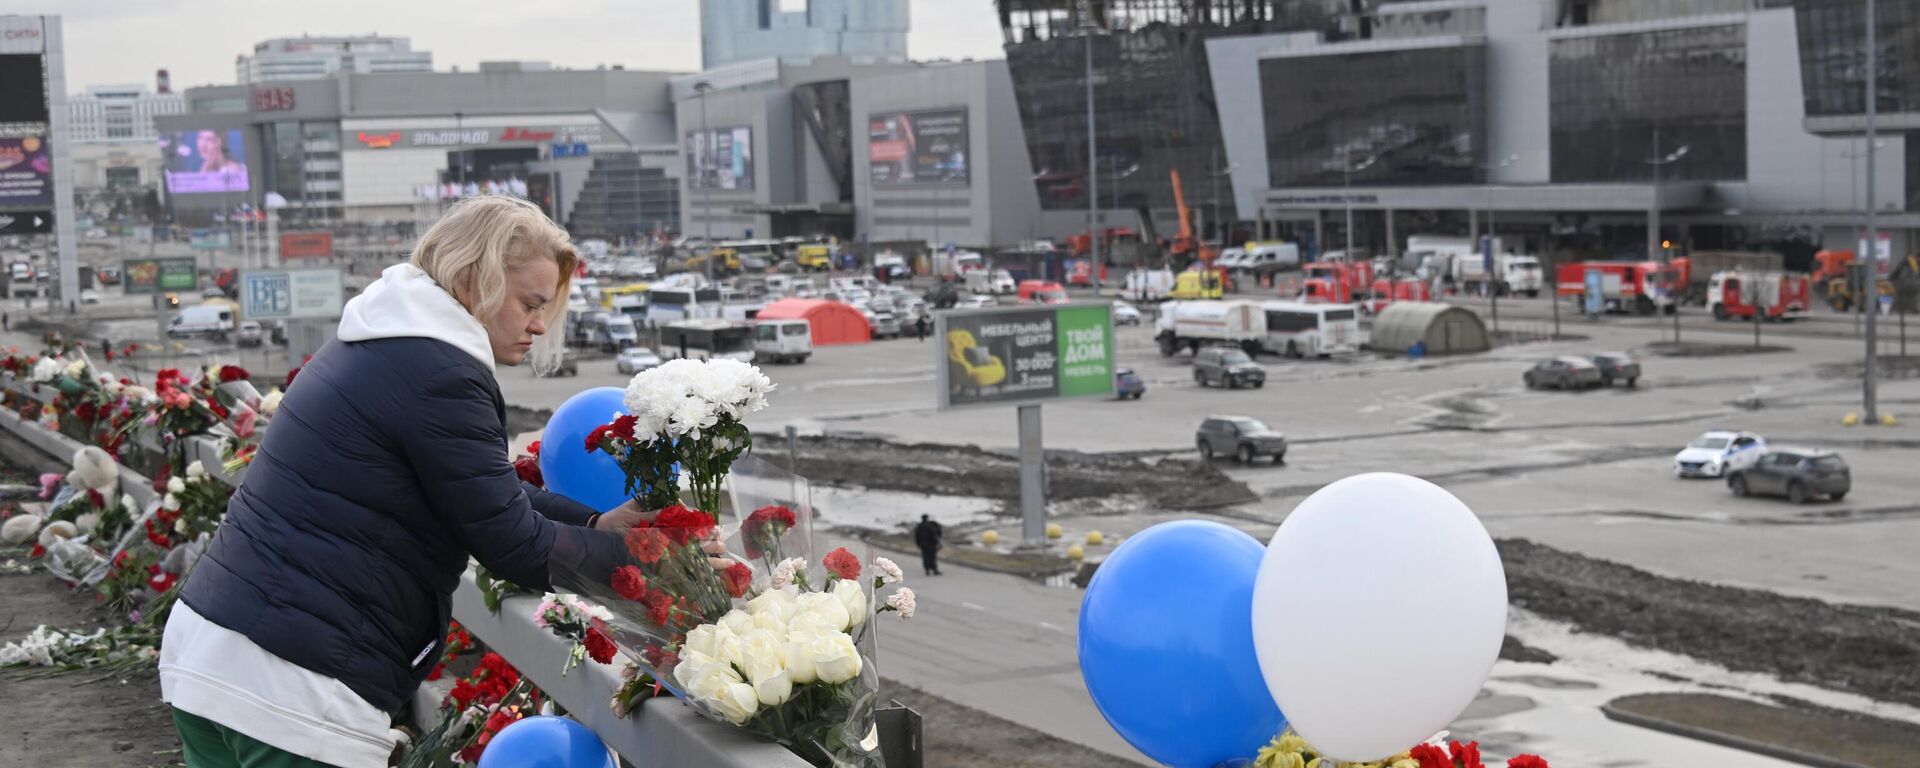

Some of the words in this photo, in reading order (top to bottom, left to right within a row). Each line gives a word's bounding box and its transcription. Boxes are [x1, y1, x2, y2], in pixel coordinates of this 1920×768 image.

[413, 130, 489, 146] ЭЛЬДОРАДО
[981, 320, 1052, 336] МЕБЕЛЬНЫЙ
[1066, 325, 1104, 344] ТВОЙ
[1016, 335, 1053, 347] ЦЕНТР
[1064, 344, 1105, 364] ДОМ
[1065, 366, 1106, 377] МЕБЕЛЬ
